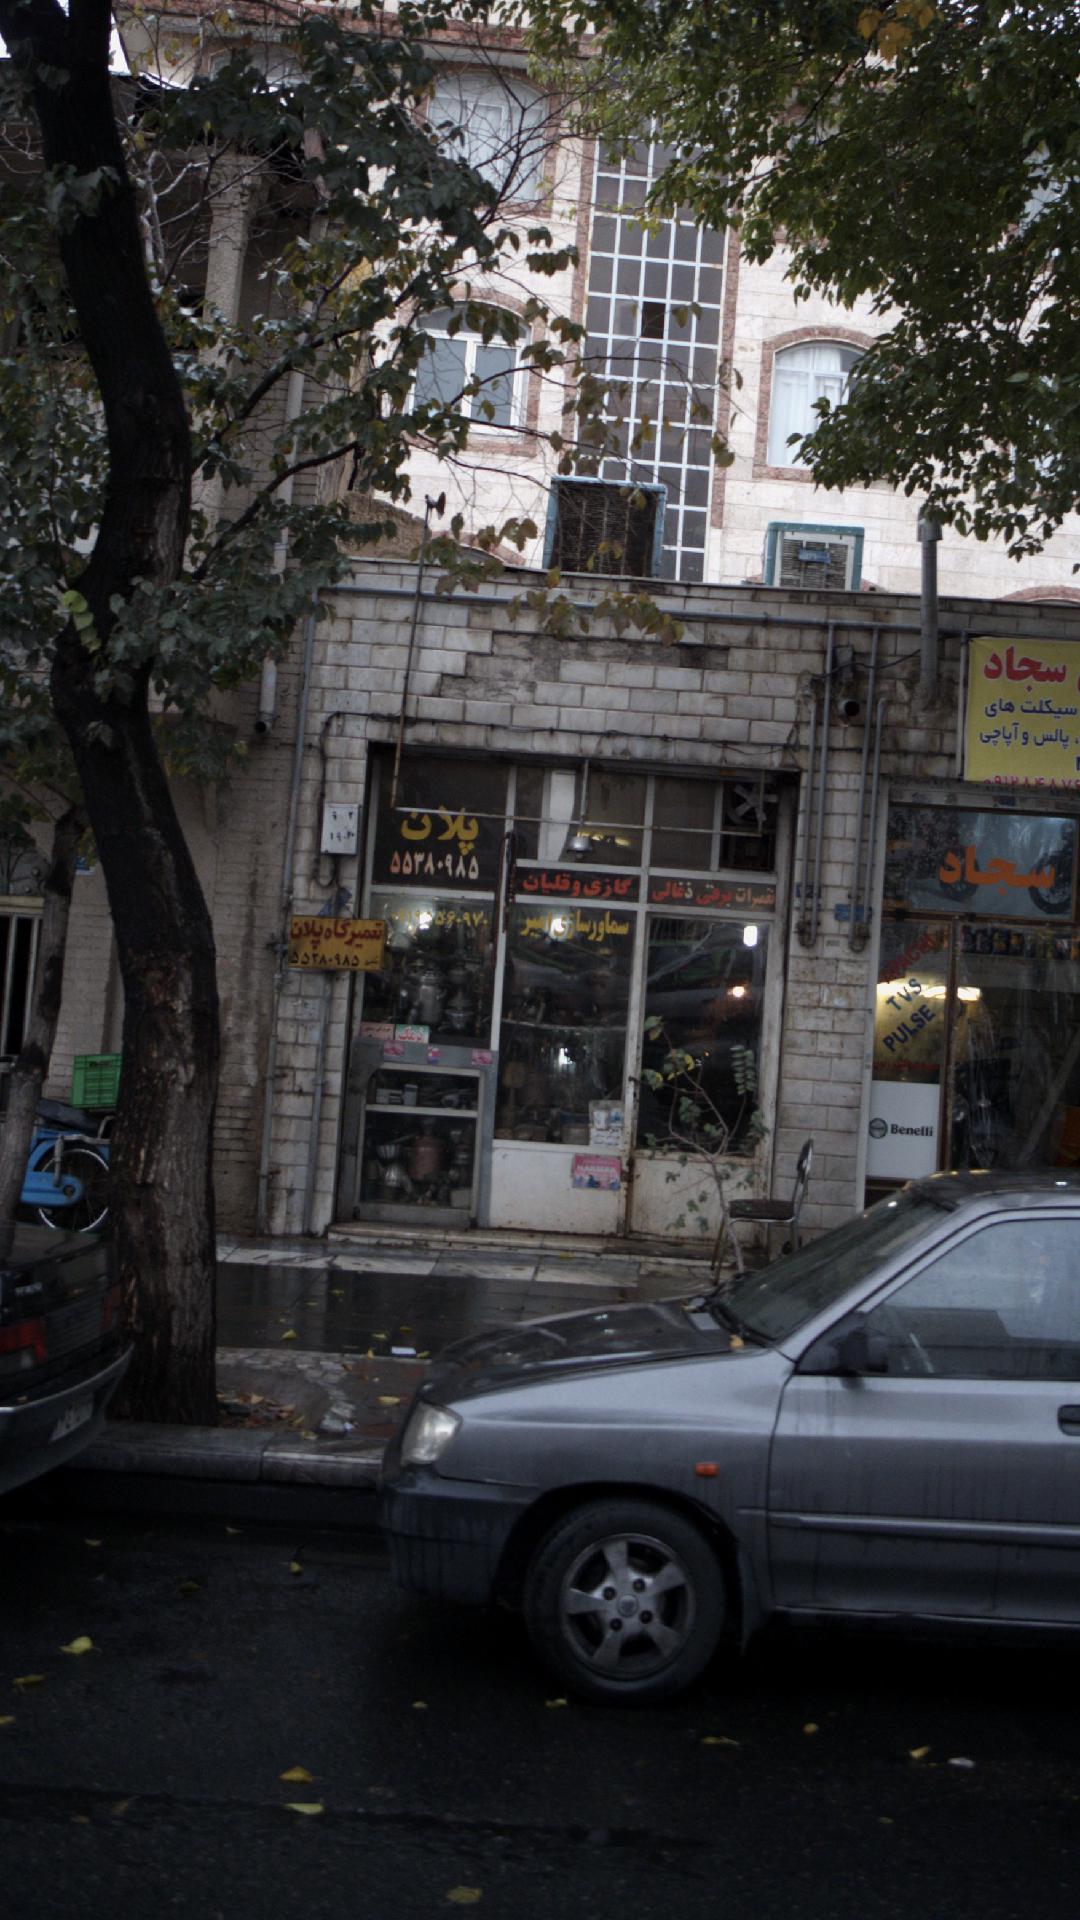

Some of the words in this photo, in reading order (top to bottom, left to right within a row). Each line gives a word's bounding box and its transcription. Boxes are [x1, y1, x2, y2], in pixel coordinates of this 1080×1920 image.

[984, 646, 1066, 692] سجاد
[985, 698, 1015, 718] های
[1033, 728, 1069, 749] پالس
[400, 804, 480, 856] پلان
[389, 850, 480, 880] ۵۵۳۸۰۹۸۵
[939, 844, 1056, 896] سجاد
[290, 919, 323, 949] پلان
[886, 978, 922, 1010] TVS
[883, 1004, 936, 1052] PULSE
[890, 1124, 934, 1137] Benelli
